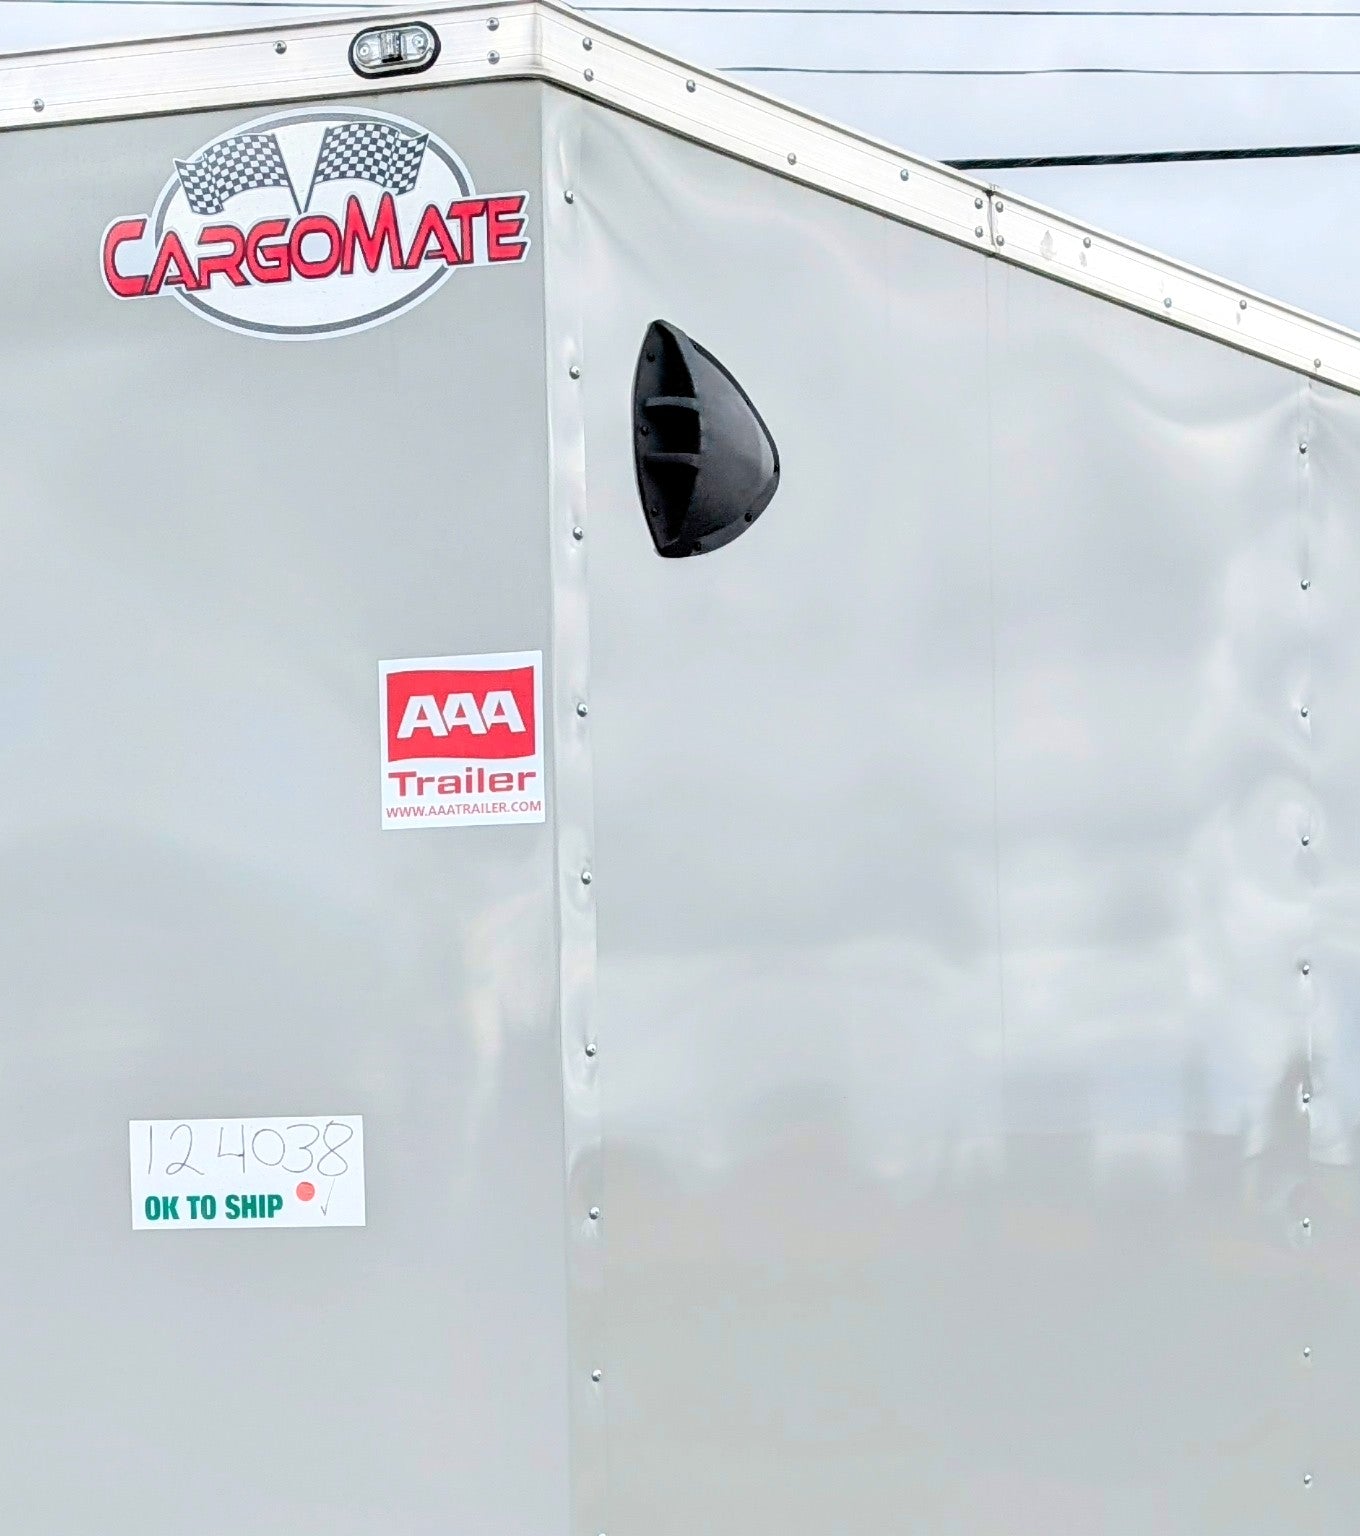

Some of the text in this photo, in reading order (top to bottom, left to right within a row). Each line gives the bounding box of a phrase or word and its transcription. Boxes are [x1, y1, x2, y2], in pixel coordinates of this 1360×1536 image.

[396, 689, 527, 739] AAA
[388, 766, 537, 797] Trailer
[386, 800, 542, 818] WWW.AAATRAILER.COM
[147, 1119, 354, 1177] 124038
[145, 1193, 283, 1221] OK TO SHIP
